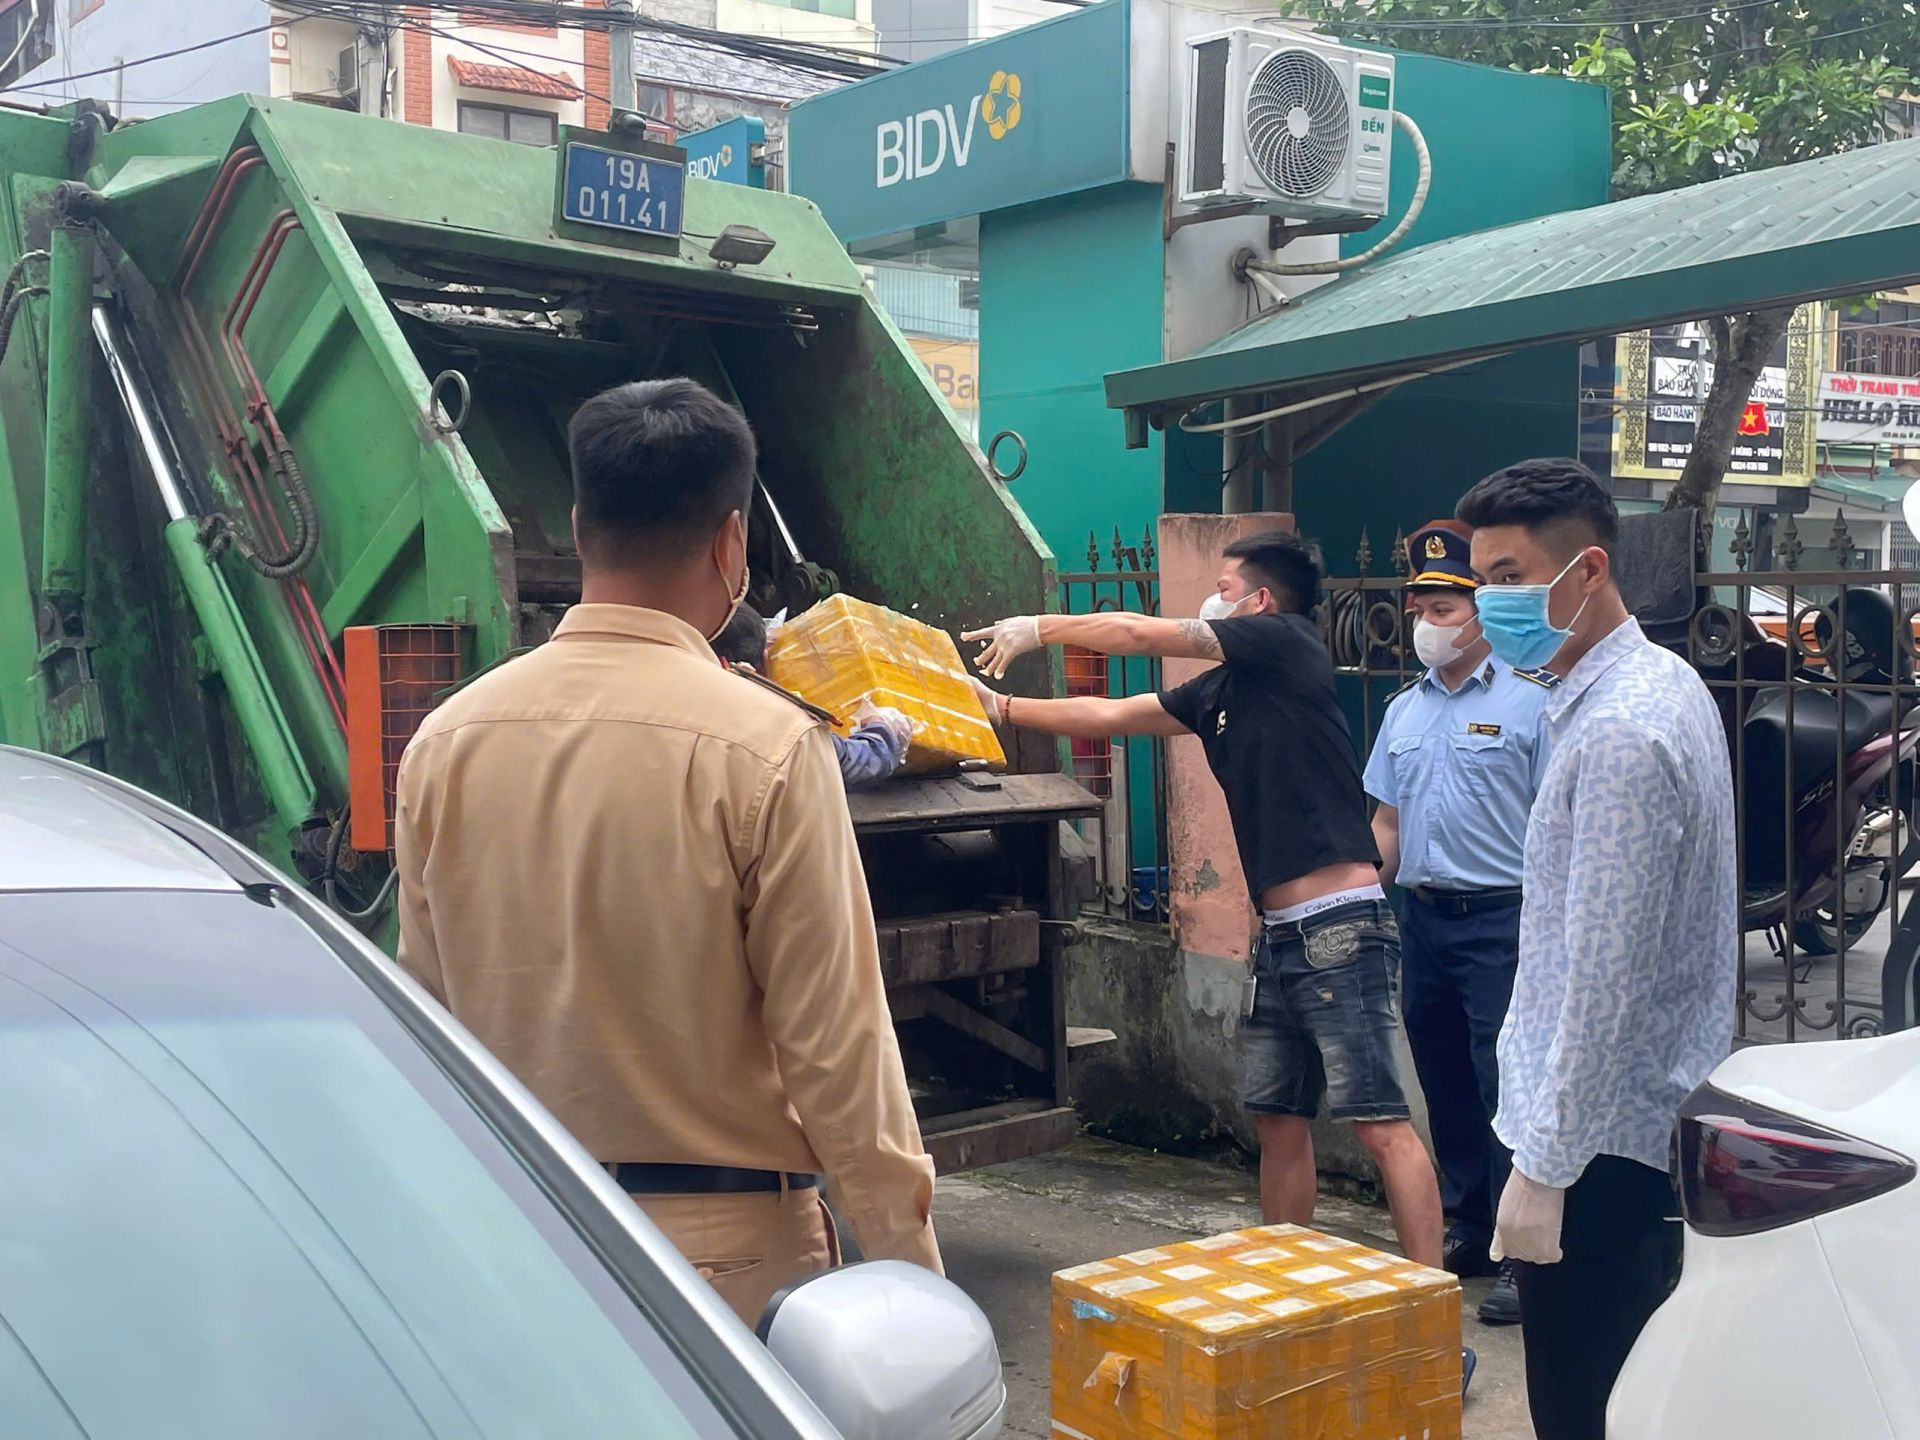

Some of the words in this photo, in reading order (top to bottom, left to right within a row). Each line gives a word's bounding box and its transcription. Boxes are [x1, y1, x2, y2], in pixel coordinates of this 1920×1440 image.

[876, 94, 983, 189] BIDV
[606, 156, 651, 193] 19A
[688, 152, 721, 180] BIDV
[578, 186, 668, 231] 011.41
[1304, 900, 1335, 914] Calvin
